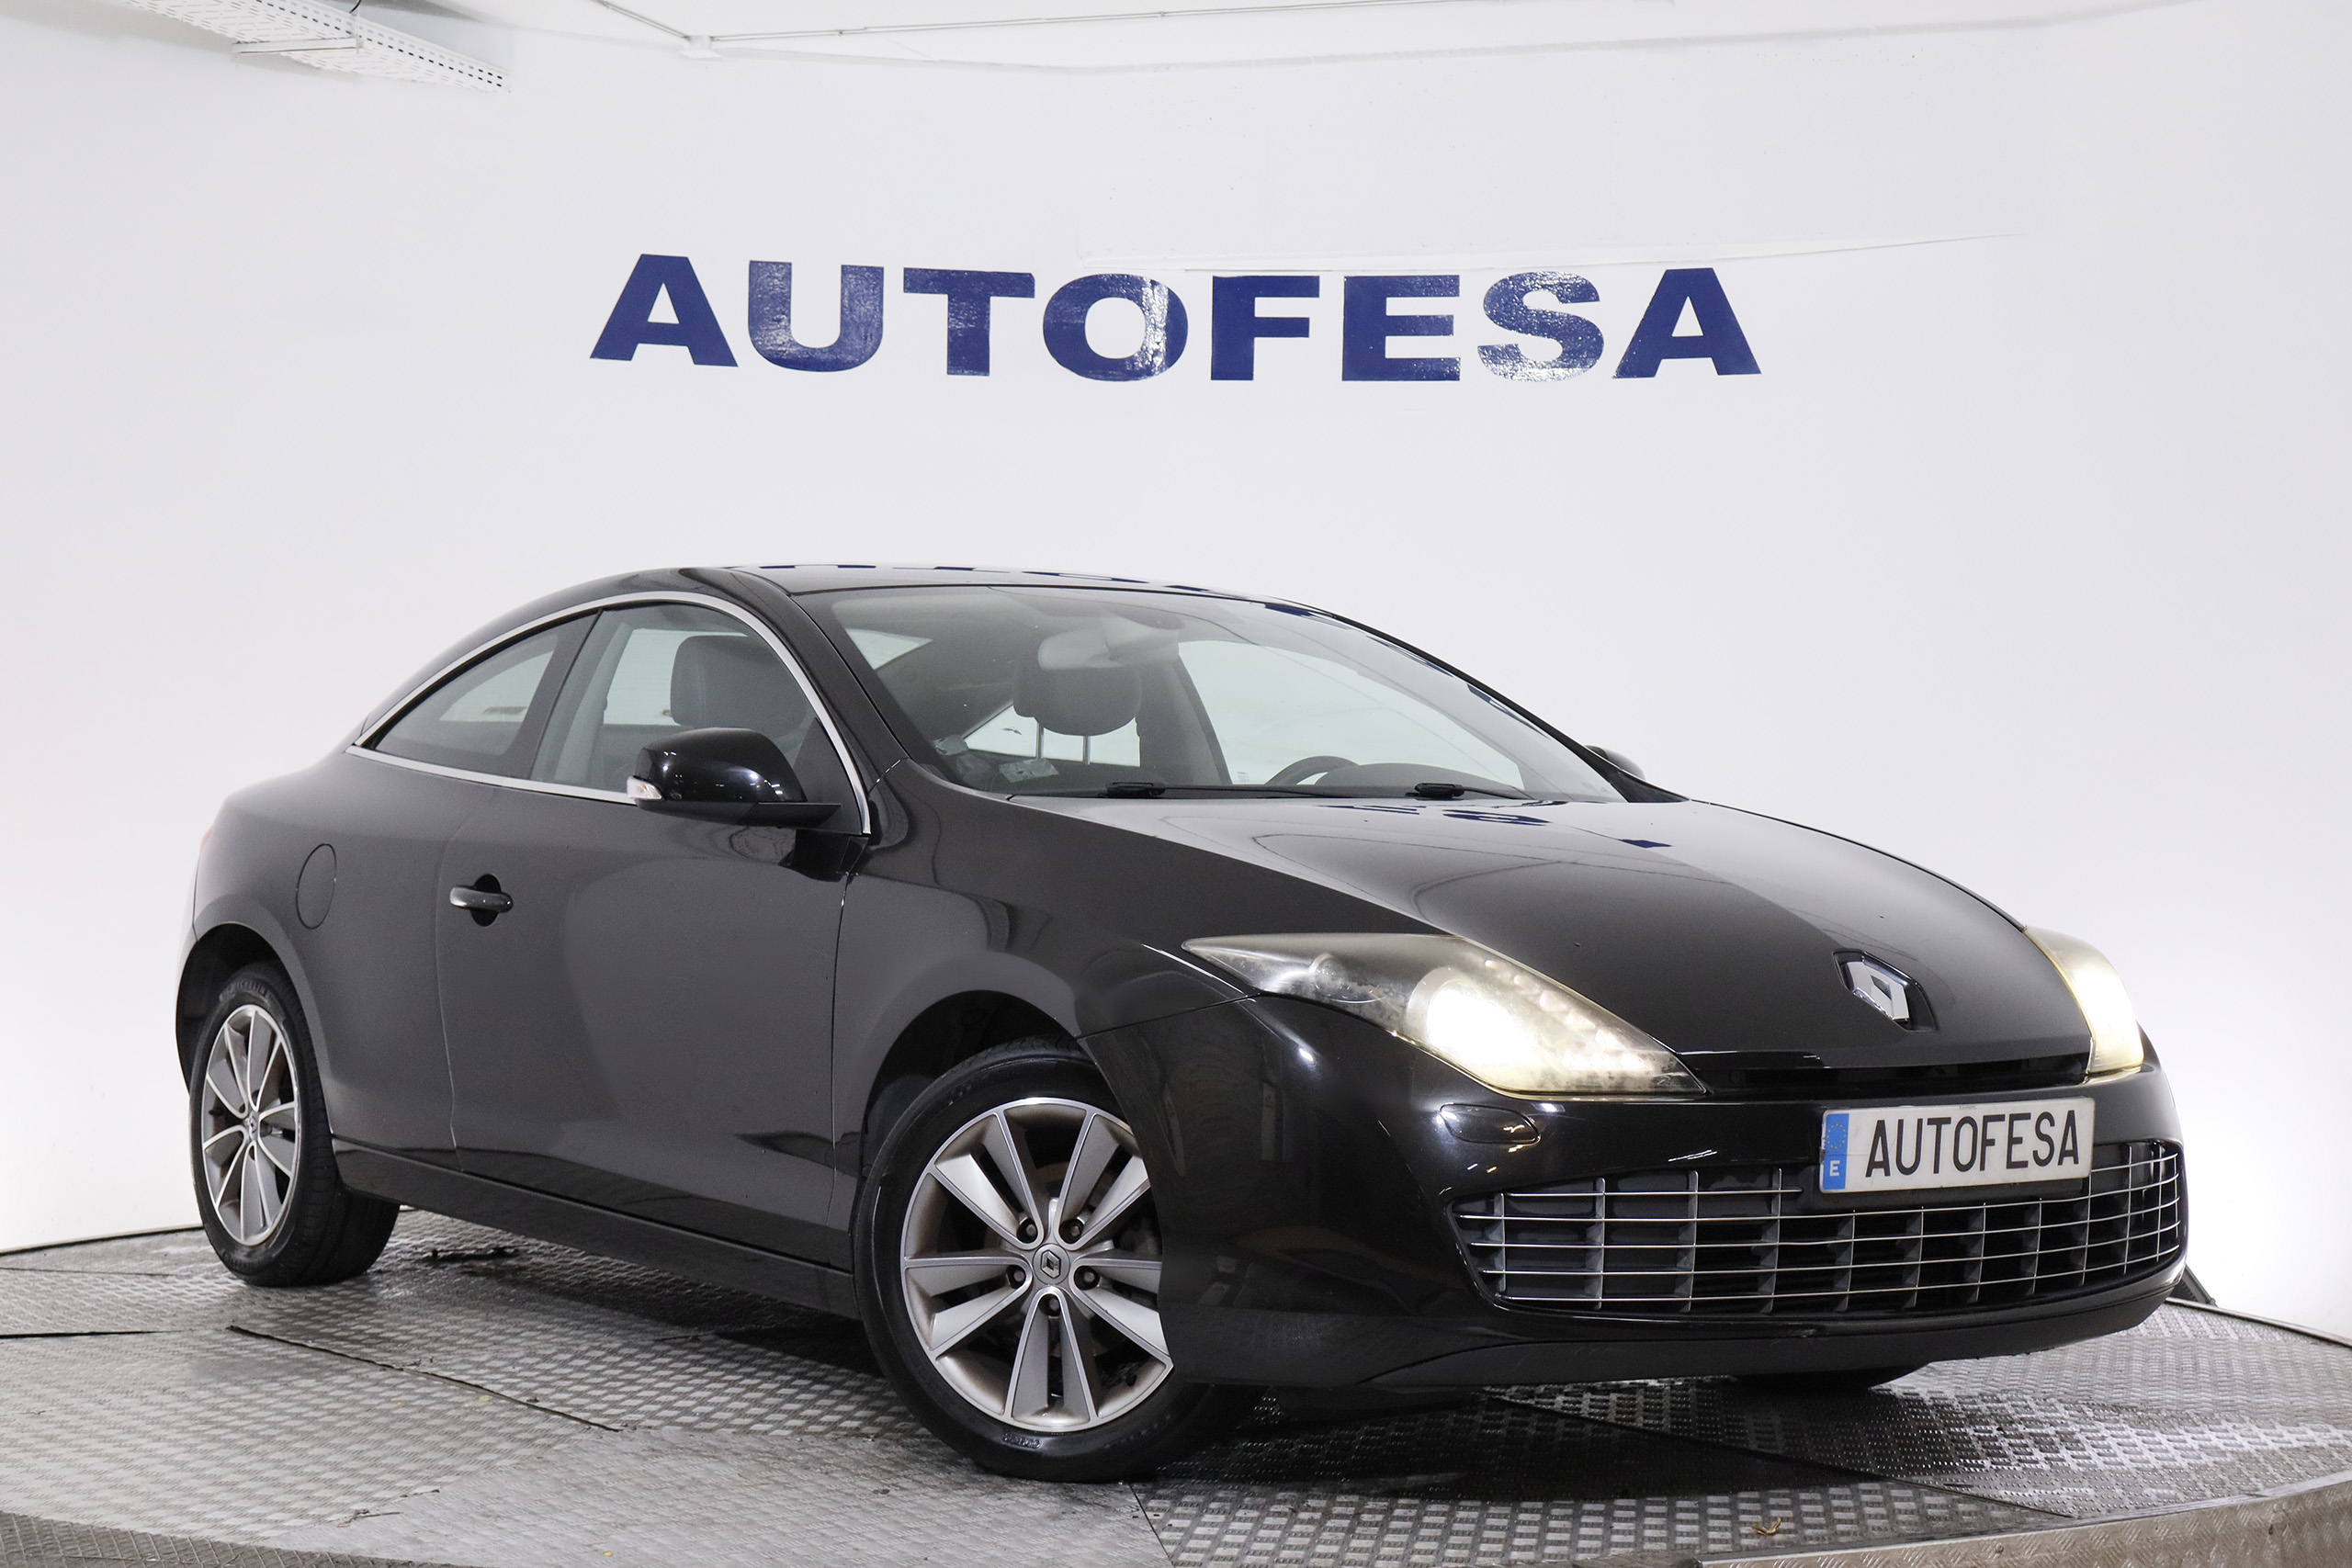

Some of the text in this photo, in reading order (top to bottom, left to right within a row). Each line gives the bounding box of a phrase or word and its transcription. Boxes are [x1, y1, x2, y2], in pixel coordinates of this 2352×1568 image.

[591, 254, 1761, 382] AUTOFESA
[1829, 1160, 1840, 1177] E
[1865, 1110, 2079, 1178] AUTOFESA
